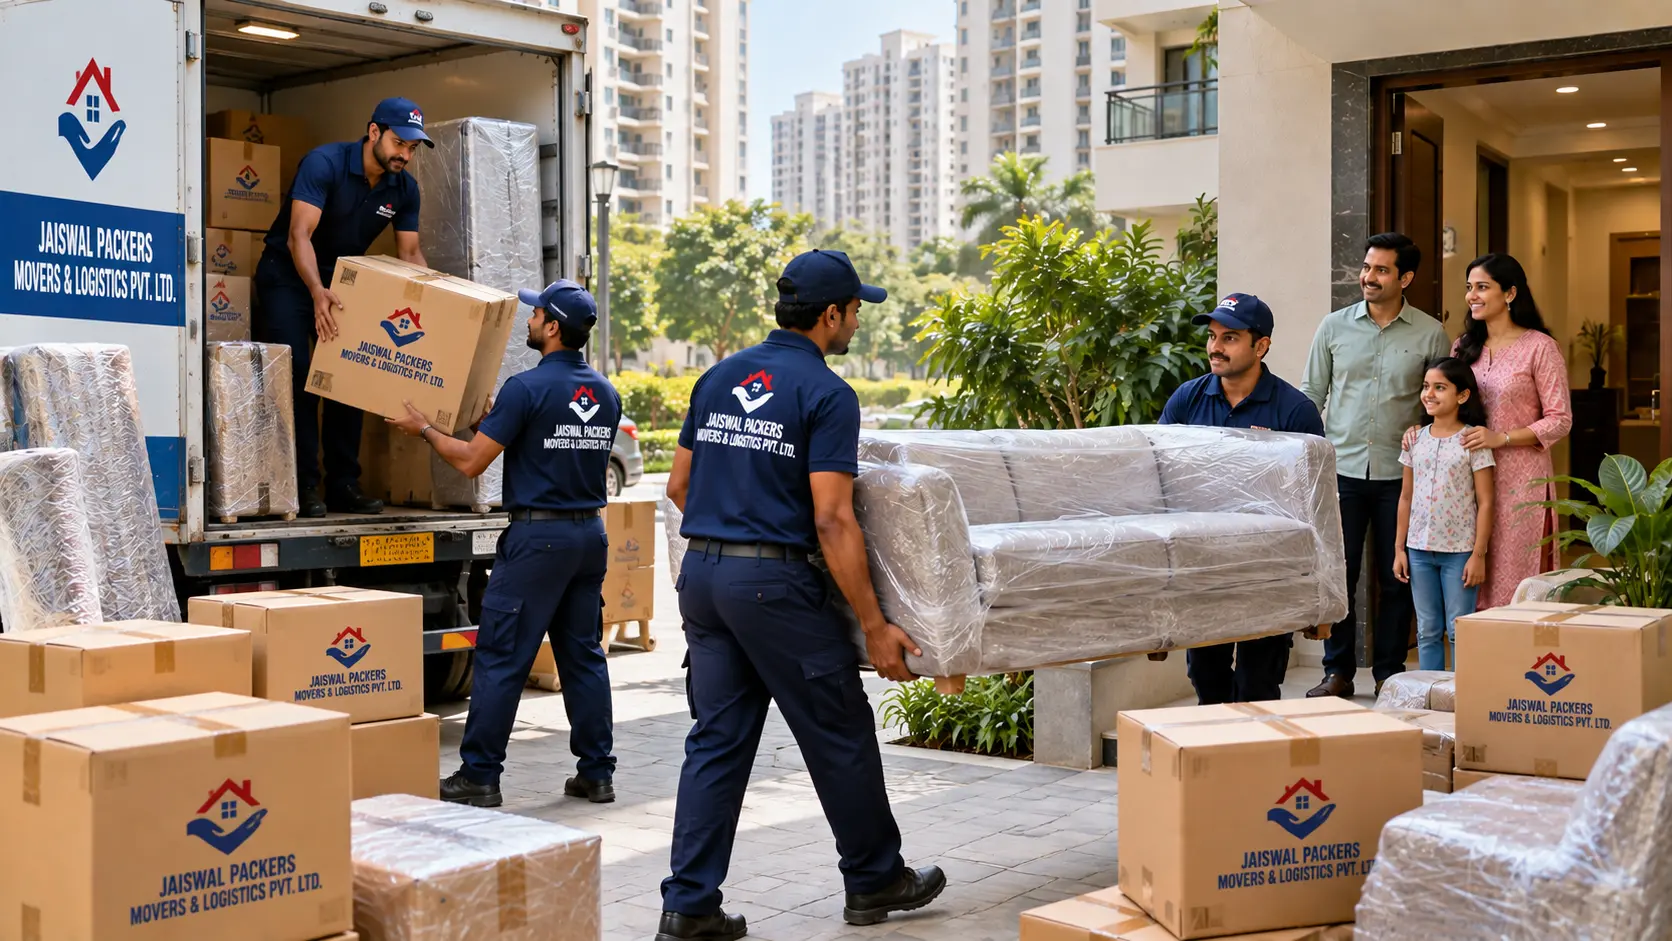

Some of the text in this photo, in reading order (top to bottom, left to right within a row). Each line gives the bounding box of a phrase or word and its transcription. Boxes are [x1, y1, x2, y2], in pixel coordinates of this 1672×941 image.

[39, 221, 153, 263] JAISWAL PACKERS
[14, 260, 177, 303] MOVERS & LOGISTICS PVT. LTD.
[394, 351, 433, 372] PACKERS
[430, 375, 444, 389] LTD.
[706, 412, 784, 439] JAISWAL PACKERS
[722, 432, 728, 444] &
[779, 442, 796, 458] LTD.
[294, 688, 325, 701] MOVERS
[388, 680, 402, 691] LTD.
[309, 669, 386, 688] JAISWAL PACKERS
[1507, 698, 1593, 715] JAISWAL PACKERS
[1489, 711, 1522, 723] MOVERS
[1525, 713, 1530, 724] &
[1532, 714, 1574, 727] LOGISTICS
[1595, 717, 1612, 730] LTD.
[1241, 842, 1360, 869] JAISWAL PACKERS
[159, 854, 296, 897] JAISWAL PACKERS
[1218, 859, 1376, 890] MOVERS & LOGISTICS PVT. LT
[130, 872, 323, 926] MOVERS & LOGISTICS PVT. LTD.
